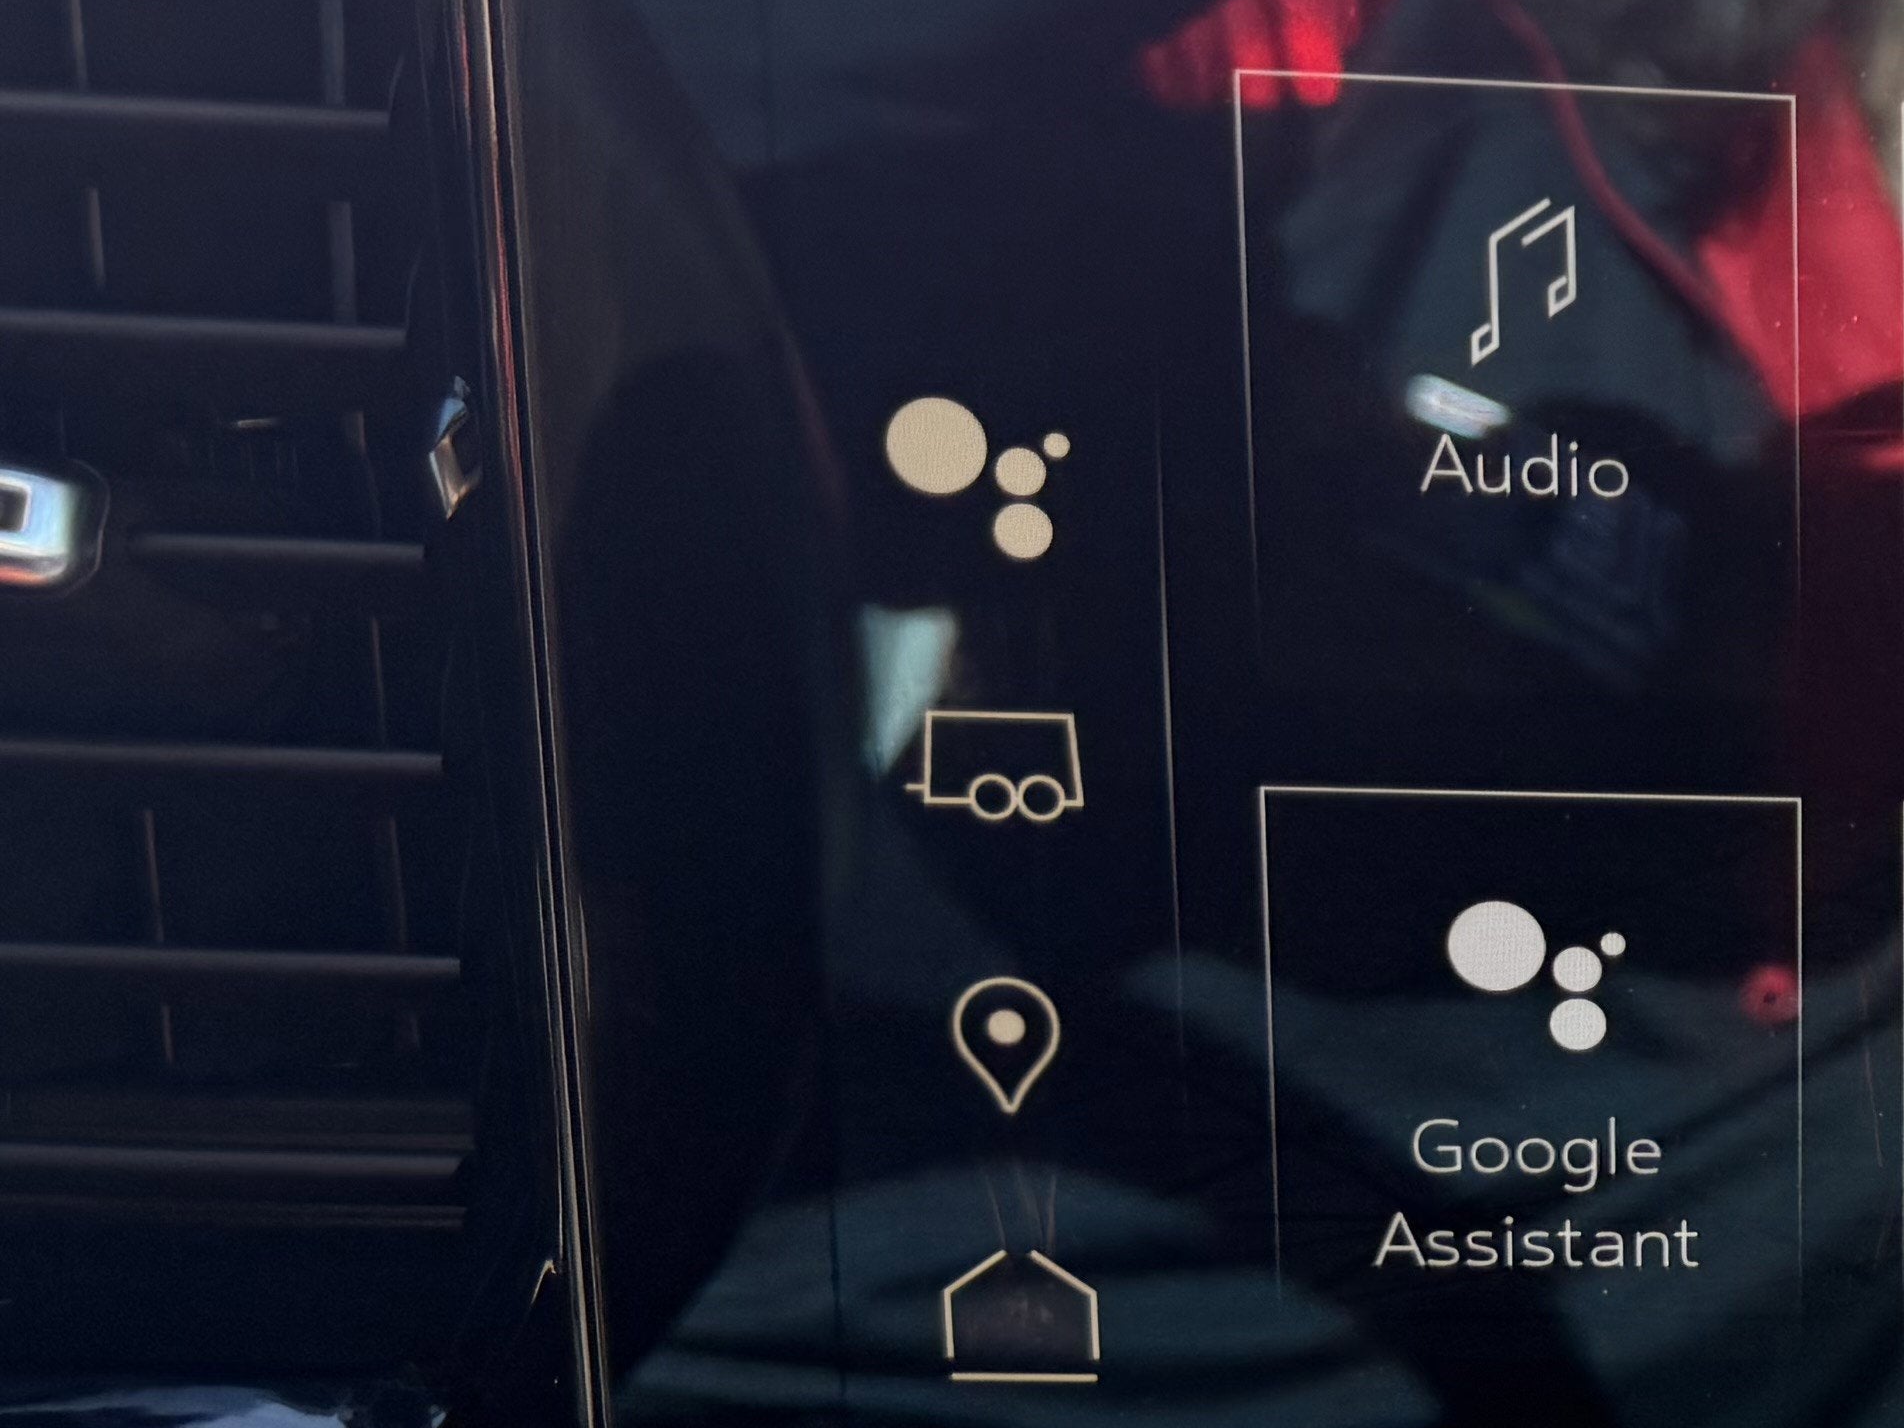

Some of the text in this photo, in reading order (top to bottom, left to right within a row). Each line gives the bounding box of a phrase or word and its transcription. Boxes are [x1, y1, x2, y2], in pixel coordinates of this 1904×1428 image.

[1419, 433, 1631, 500] Audio
[1411, 1116, 1664, 1193] Google
[1373, 1211, 1701, 1269] Assistant
